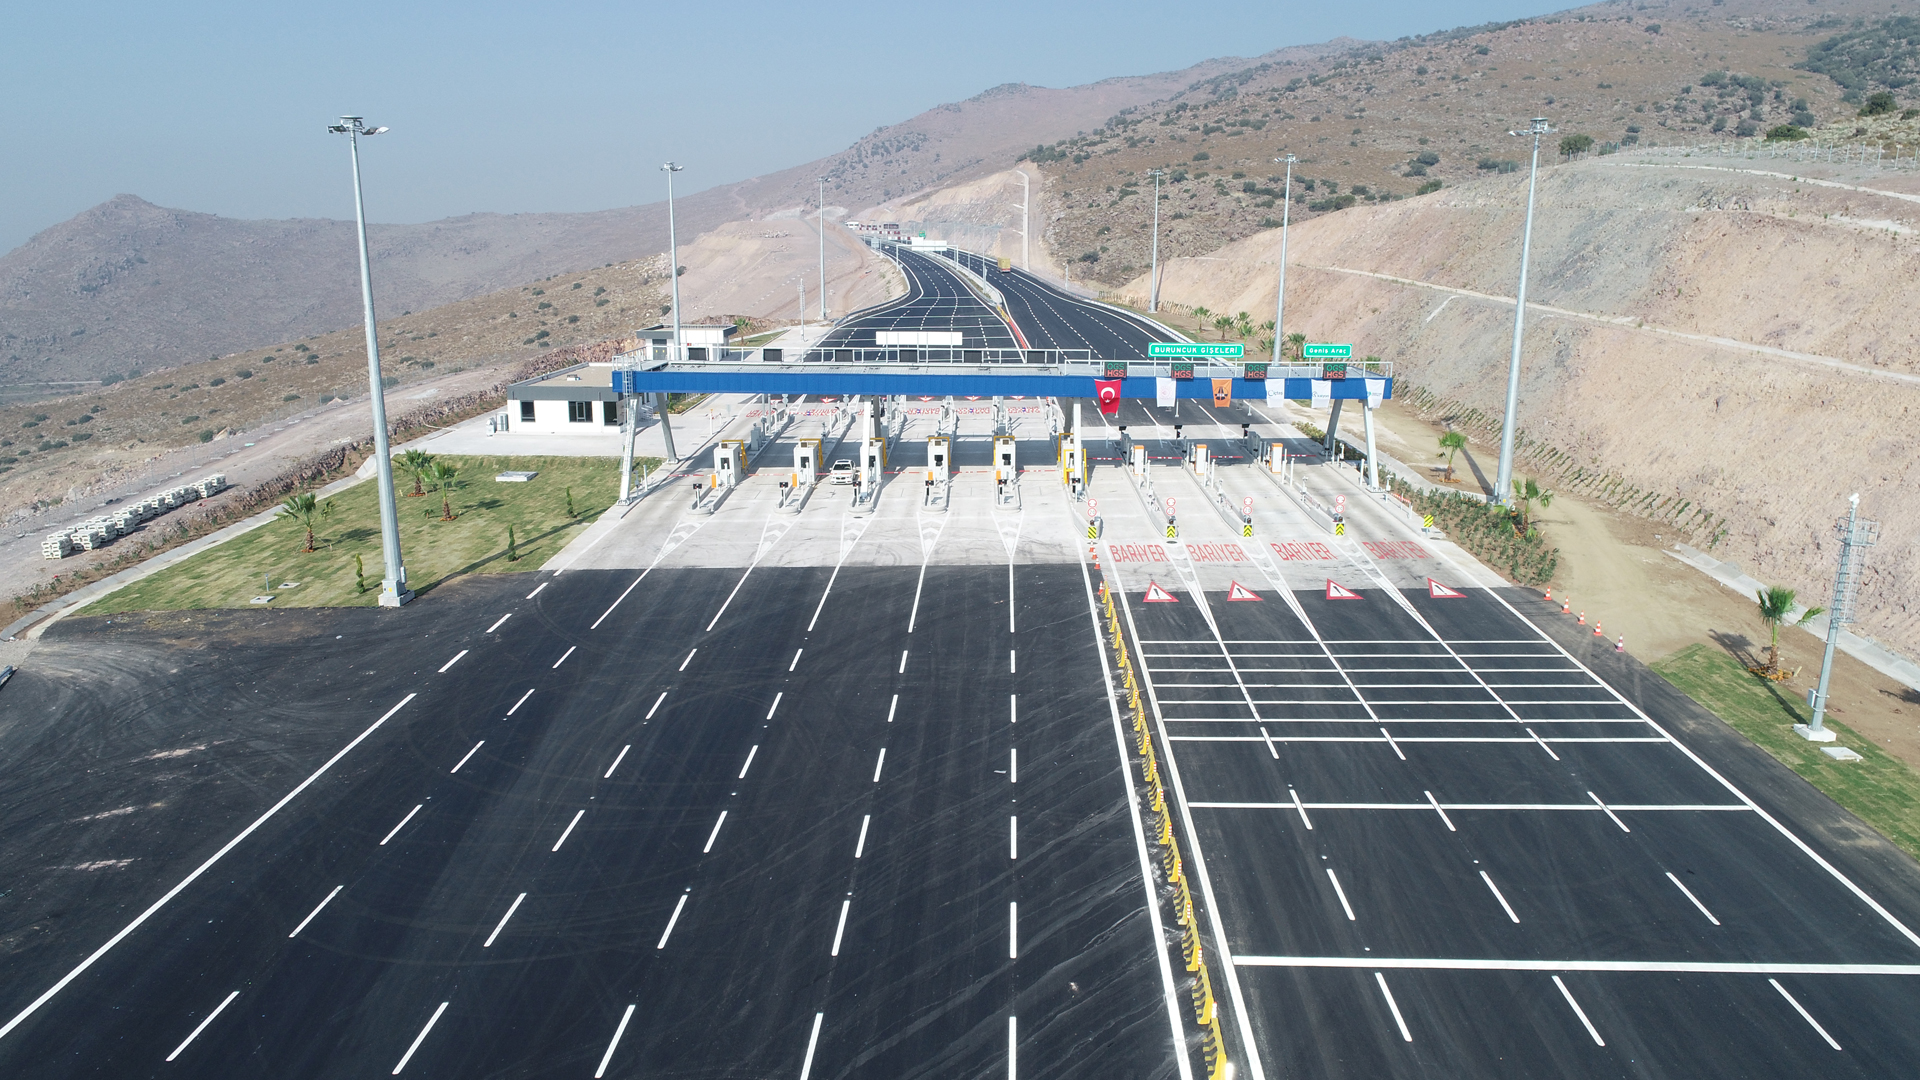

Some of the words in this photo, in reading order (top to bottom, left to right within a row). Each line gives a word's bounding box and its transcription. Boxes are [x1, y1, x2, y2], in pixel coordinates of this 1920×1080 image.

[1154, 346, 1197, 354] BURUNCUK
[1200, 345, 1238, 354] GİŞELERİ
[1107, 362, 1125, 370] OGS
[1173, 363, 1191, 371] OGS
[1247, 363, 1265, 371] OGS
[1326, 363, 1344, 371] OGS
[1109, 542, 1170, 563] BARİYER
[1186, 541, 1250, 562] BARİYER
[1270, 539, 1338, 561] BARİYER
[1362, 538, 1434, 559] BARİYER
